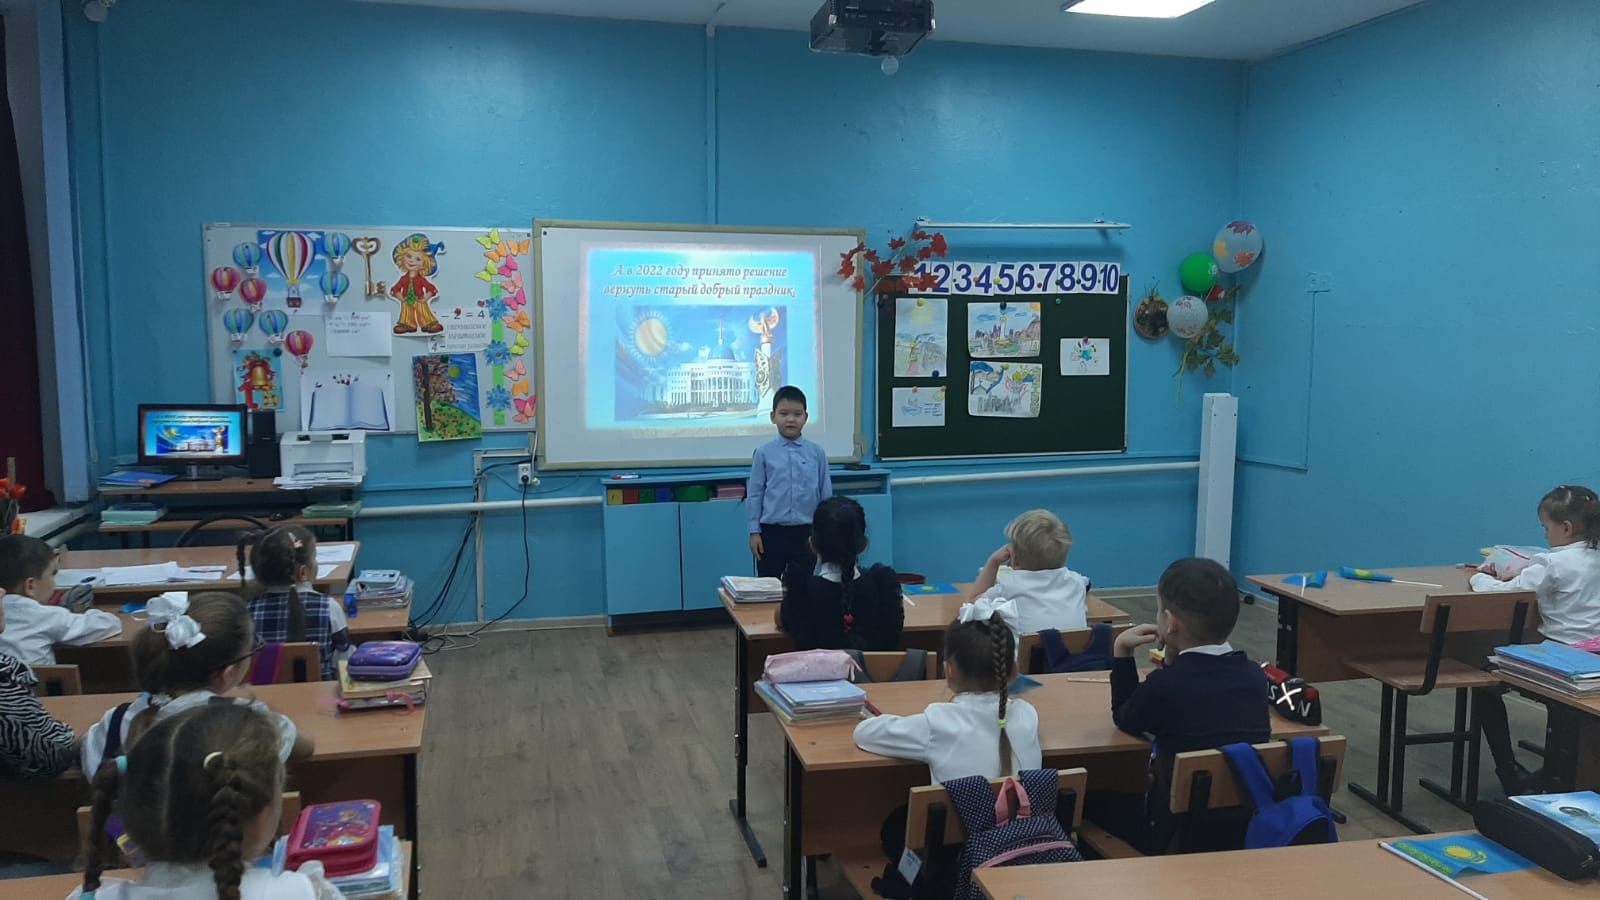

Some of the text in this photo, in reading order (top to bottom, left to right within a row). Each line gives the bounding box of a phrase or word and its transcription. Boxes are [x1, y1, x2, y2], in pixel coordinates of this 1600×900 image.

[611, 264, 788, 280] А в 2022 году принято решение
[603, 285, 652, 298] вернуть
[654, 284, 699, 298] старый
[700, 283, 741, 298] добрый
